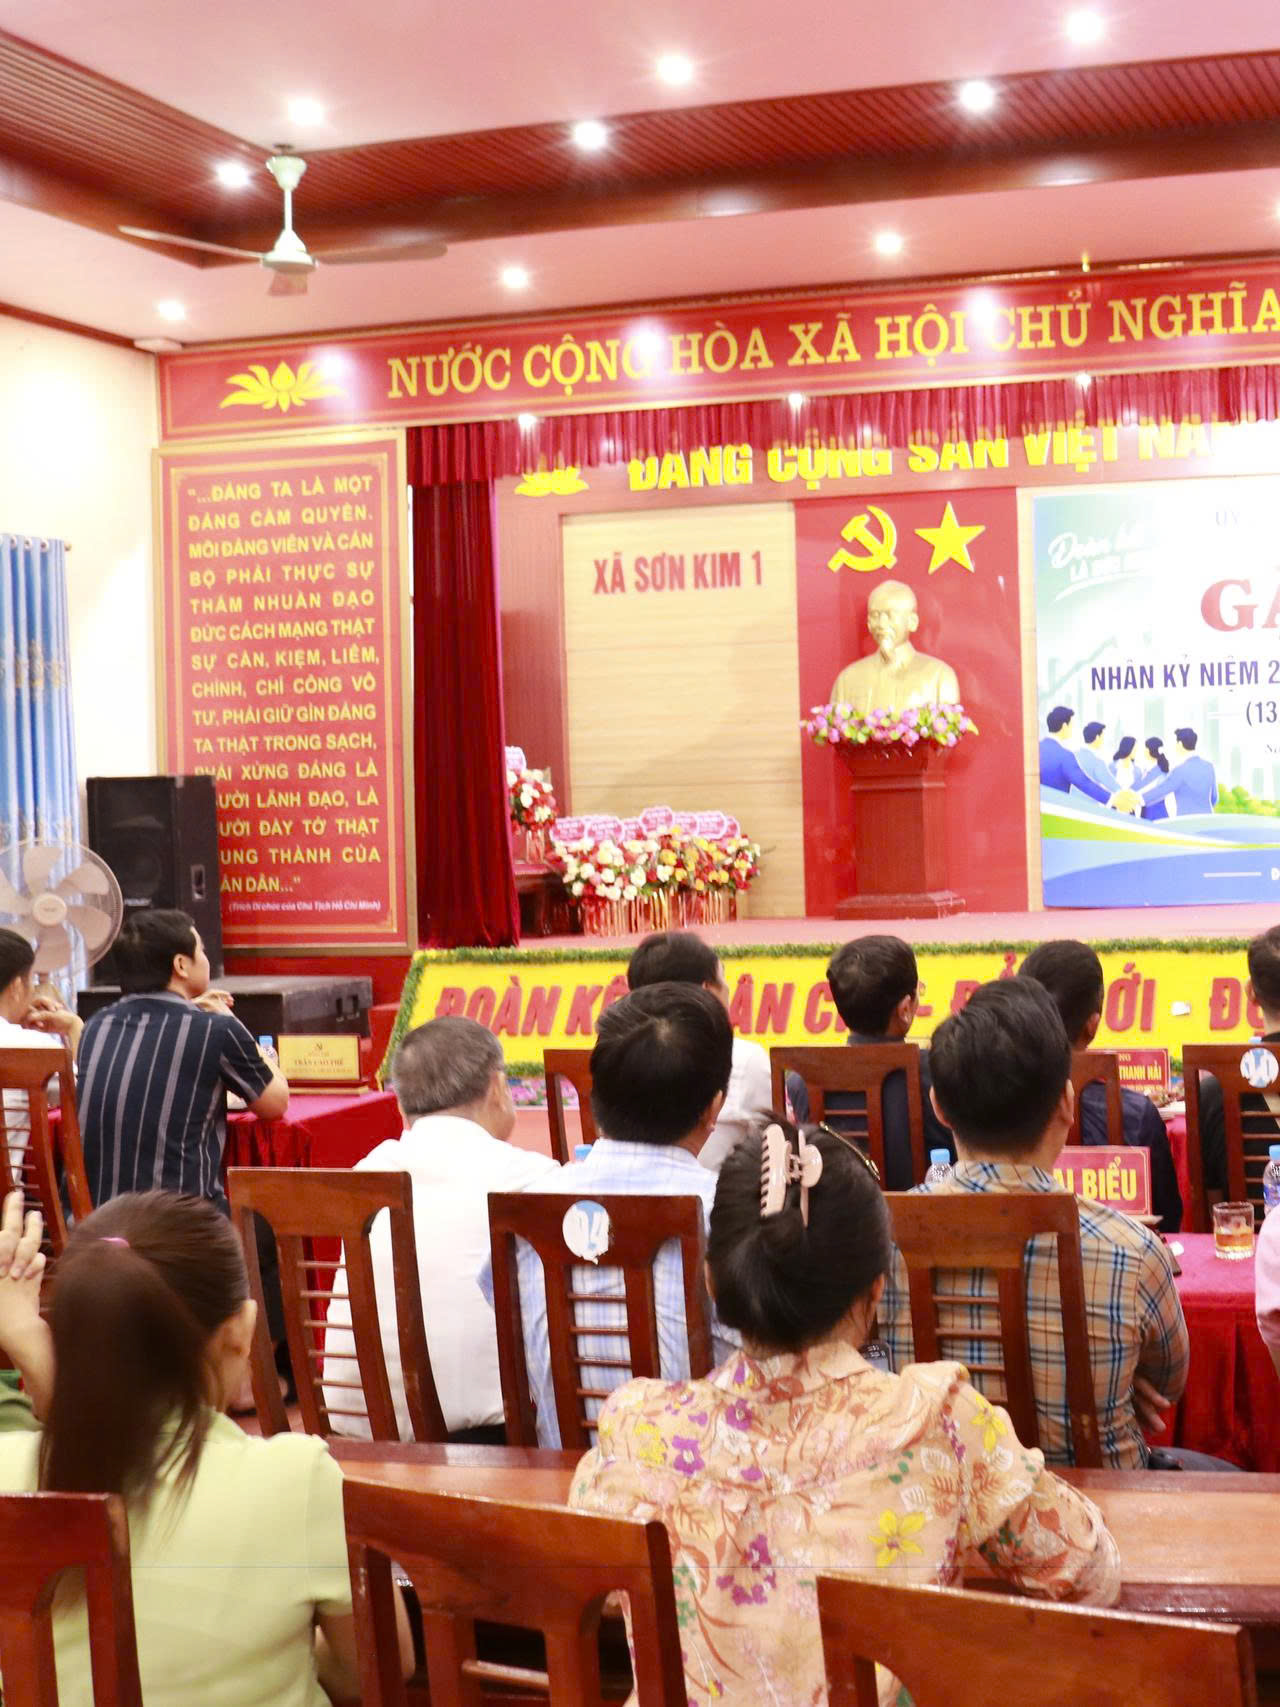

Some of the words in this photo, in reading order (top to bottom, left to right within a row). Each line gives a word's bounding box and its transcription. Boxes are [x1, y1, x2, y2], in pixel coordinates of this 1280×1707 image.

[387, 343, 511, 397] NƯỚC
[524, 334, 655, 395] CỘNG
[671, 320, 773, 375] HÒA
[787, 313, 861, 366] XÃ
[876, 303, 968, 366] HỘI
[987, 288, 1090, 352] CHỦ
[271, 481, 292, 497] TA
[302, 476, 325, 496] LÀ
[312, 534, 335, 551] VÀ
[594, 552, 626, 594] XÃ
[634, 552, 685, 592] SƠN
[693, 552, 740, 590] KIM
[752, 550, 761, 585] 1
[332, 590, 374, 610] ĐẠO
[278, 619, 328, 640] MẠNG
[352, 672, 376, 691] VÔ
[193, 739, 213, 754] TA
[264, 734, 322, 751] TRONG
[356, 757, 378, 777] LÀ
[356, 786, 379, 806] LÀ
[220, 848, 258, 865] UNG
[1082, 1156, 1137, 1201] BIỂU
